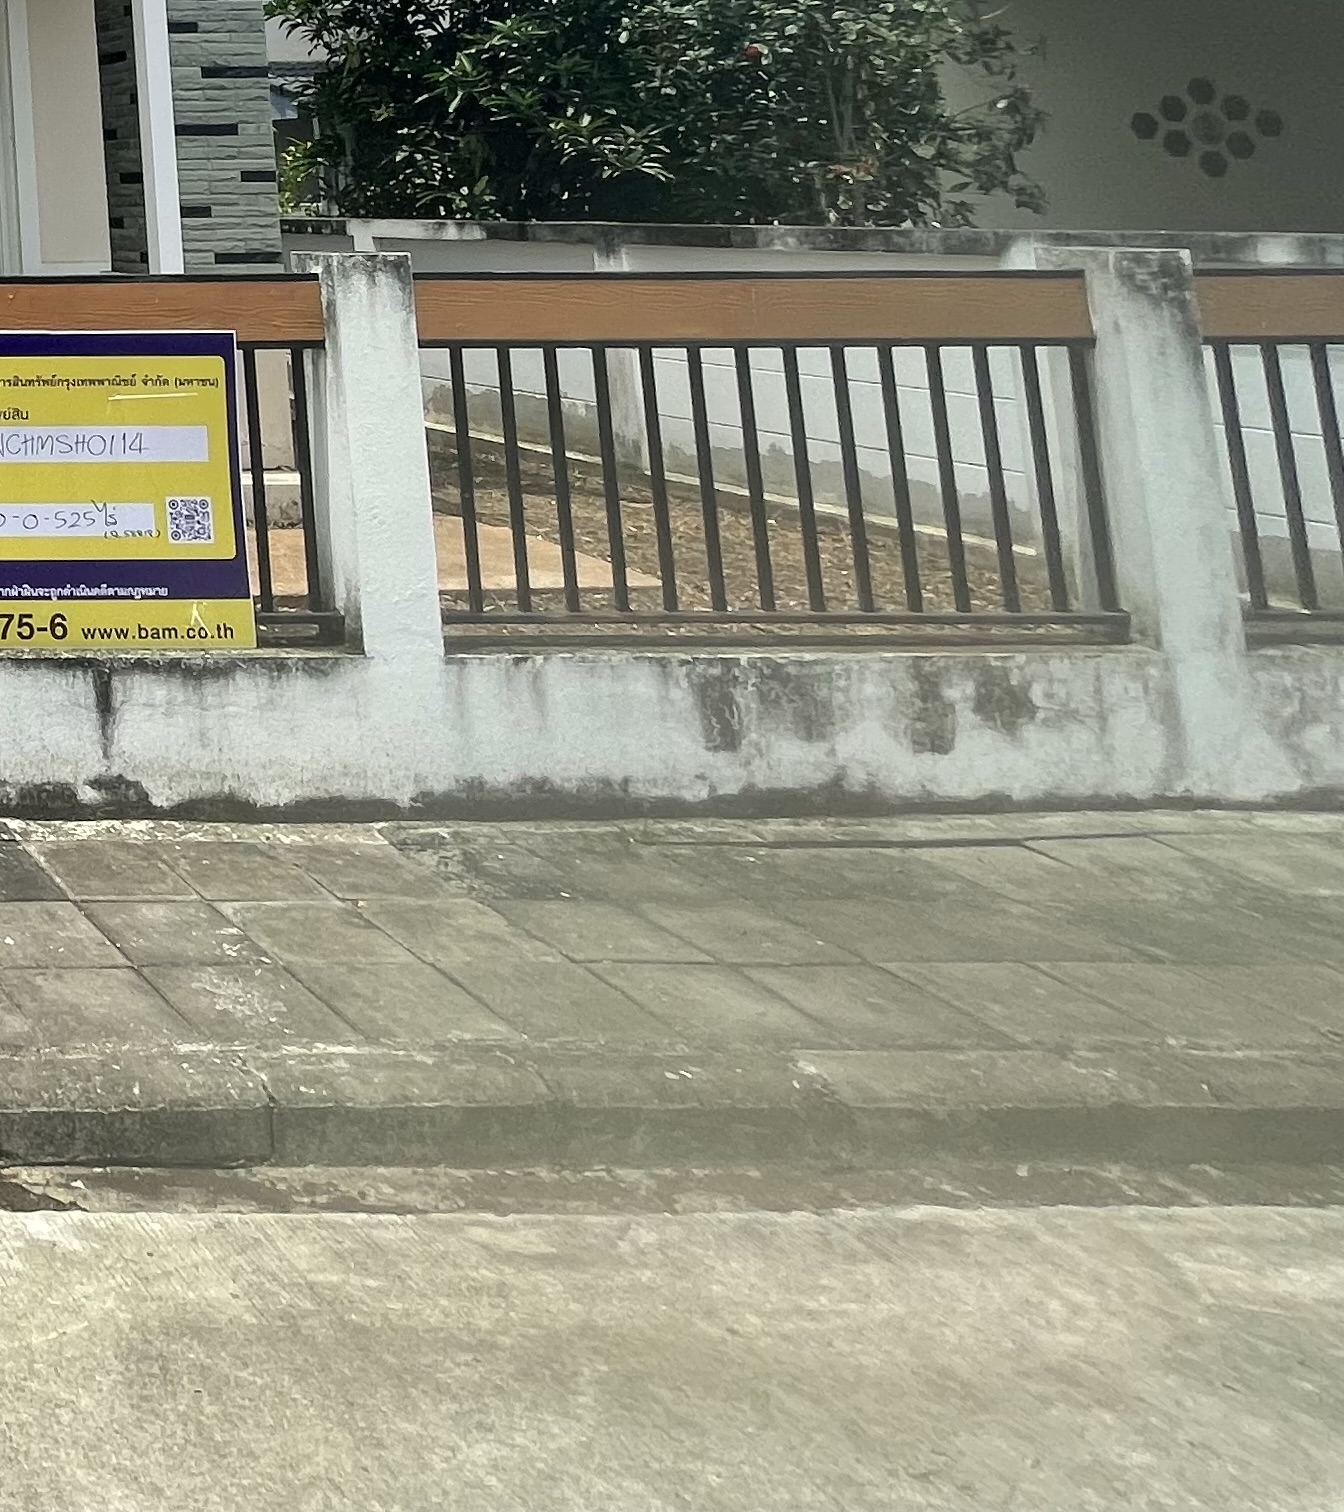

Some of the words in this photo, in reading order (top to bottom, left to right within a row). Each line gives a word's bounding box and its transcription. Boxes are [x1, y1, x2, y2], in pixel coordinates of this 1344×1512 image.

[141, 374, 170, 387] จำกัด
[174, 377, 219, 389] (มหาชน)
[81, 622, 235, 640] www.bam.co.th
